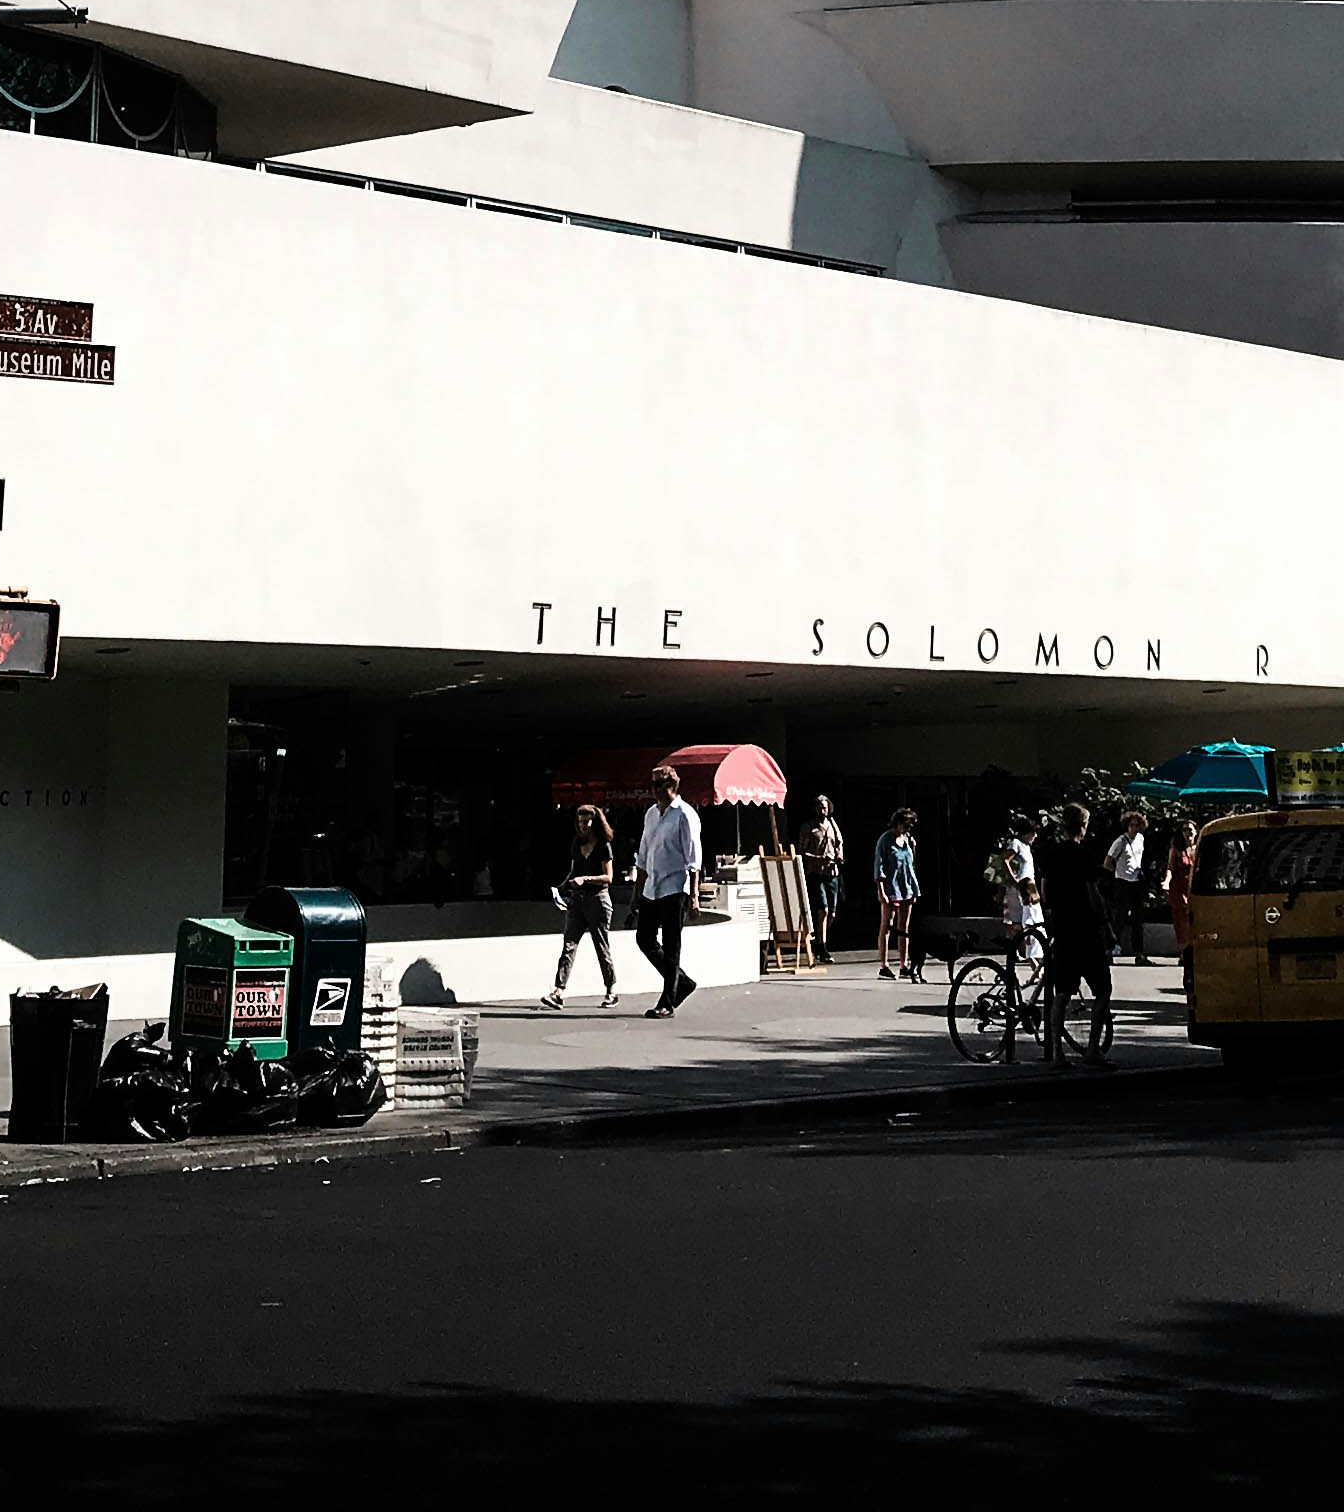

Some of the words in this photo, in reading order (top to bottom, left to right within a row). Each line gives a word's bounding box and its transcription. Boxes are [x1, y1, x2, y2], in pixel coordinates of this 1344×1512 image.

[15, 307, 26, 332] 5
[33, 309, 57, 335] Av
[72, 350, 111, 380] Mile
[532, 602, 683, 649] THE
[811, 618, 1161, 671] SOLOMON
[1256, 644, 1269, 677] R
[236, 991, 267, 1004] OUR
[236, 1004, 282, 1017] TOWN
